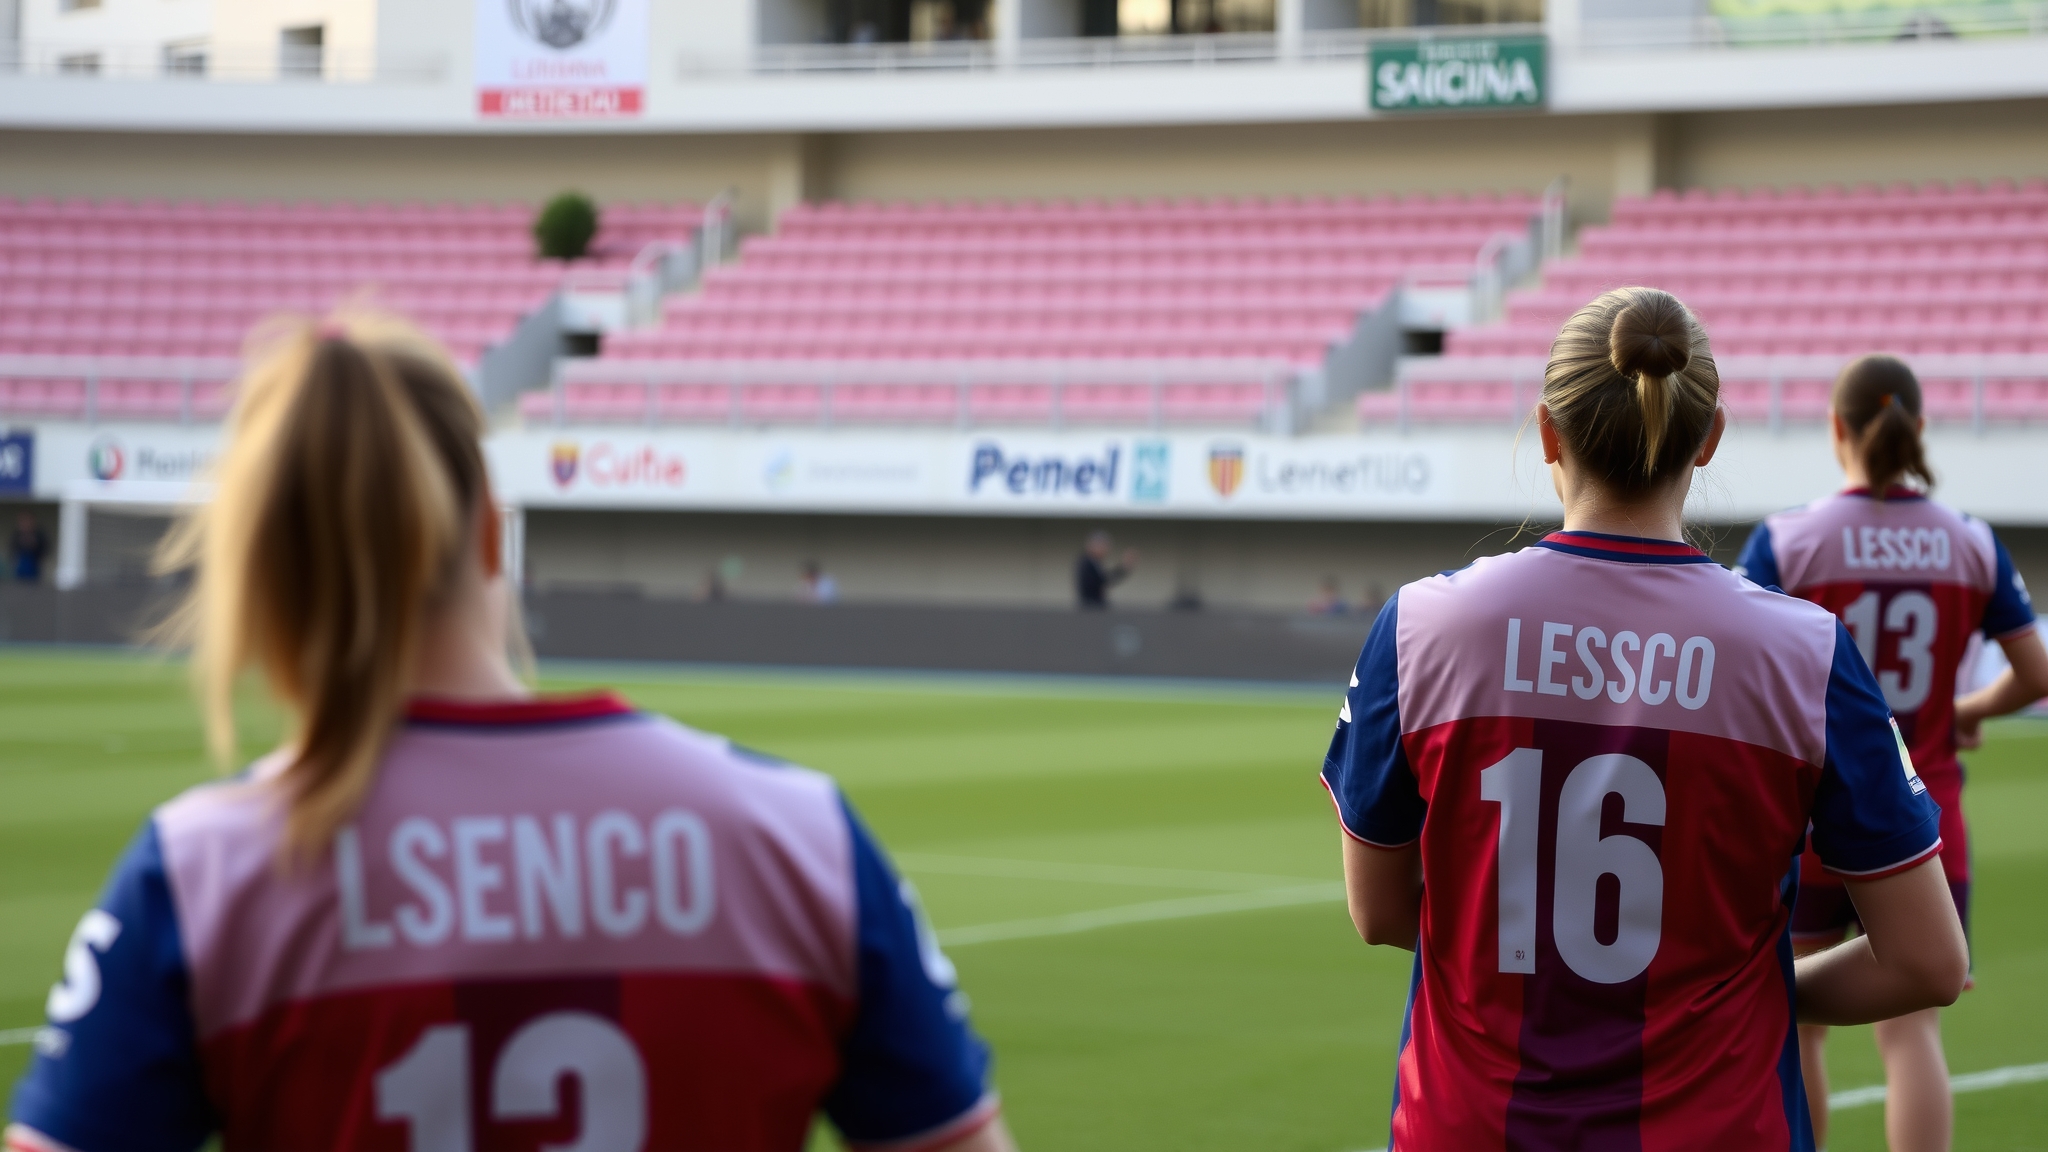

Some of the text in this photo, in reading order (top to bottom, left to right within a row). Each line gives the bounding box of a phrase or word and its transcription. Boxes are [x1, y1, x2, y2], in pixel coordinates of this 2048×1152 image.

[1843, 526, 1951, 570] LESSCO
[1503, 617, 1716, 711] LESSCO
[1843, 590, 1939, 713] 13
[335, 808, 717, 950] LSENCO
[1480, 746, 1667, 985] 16
